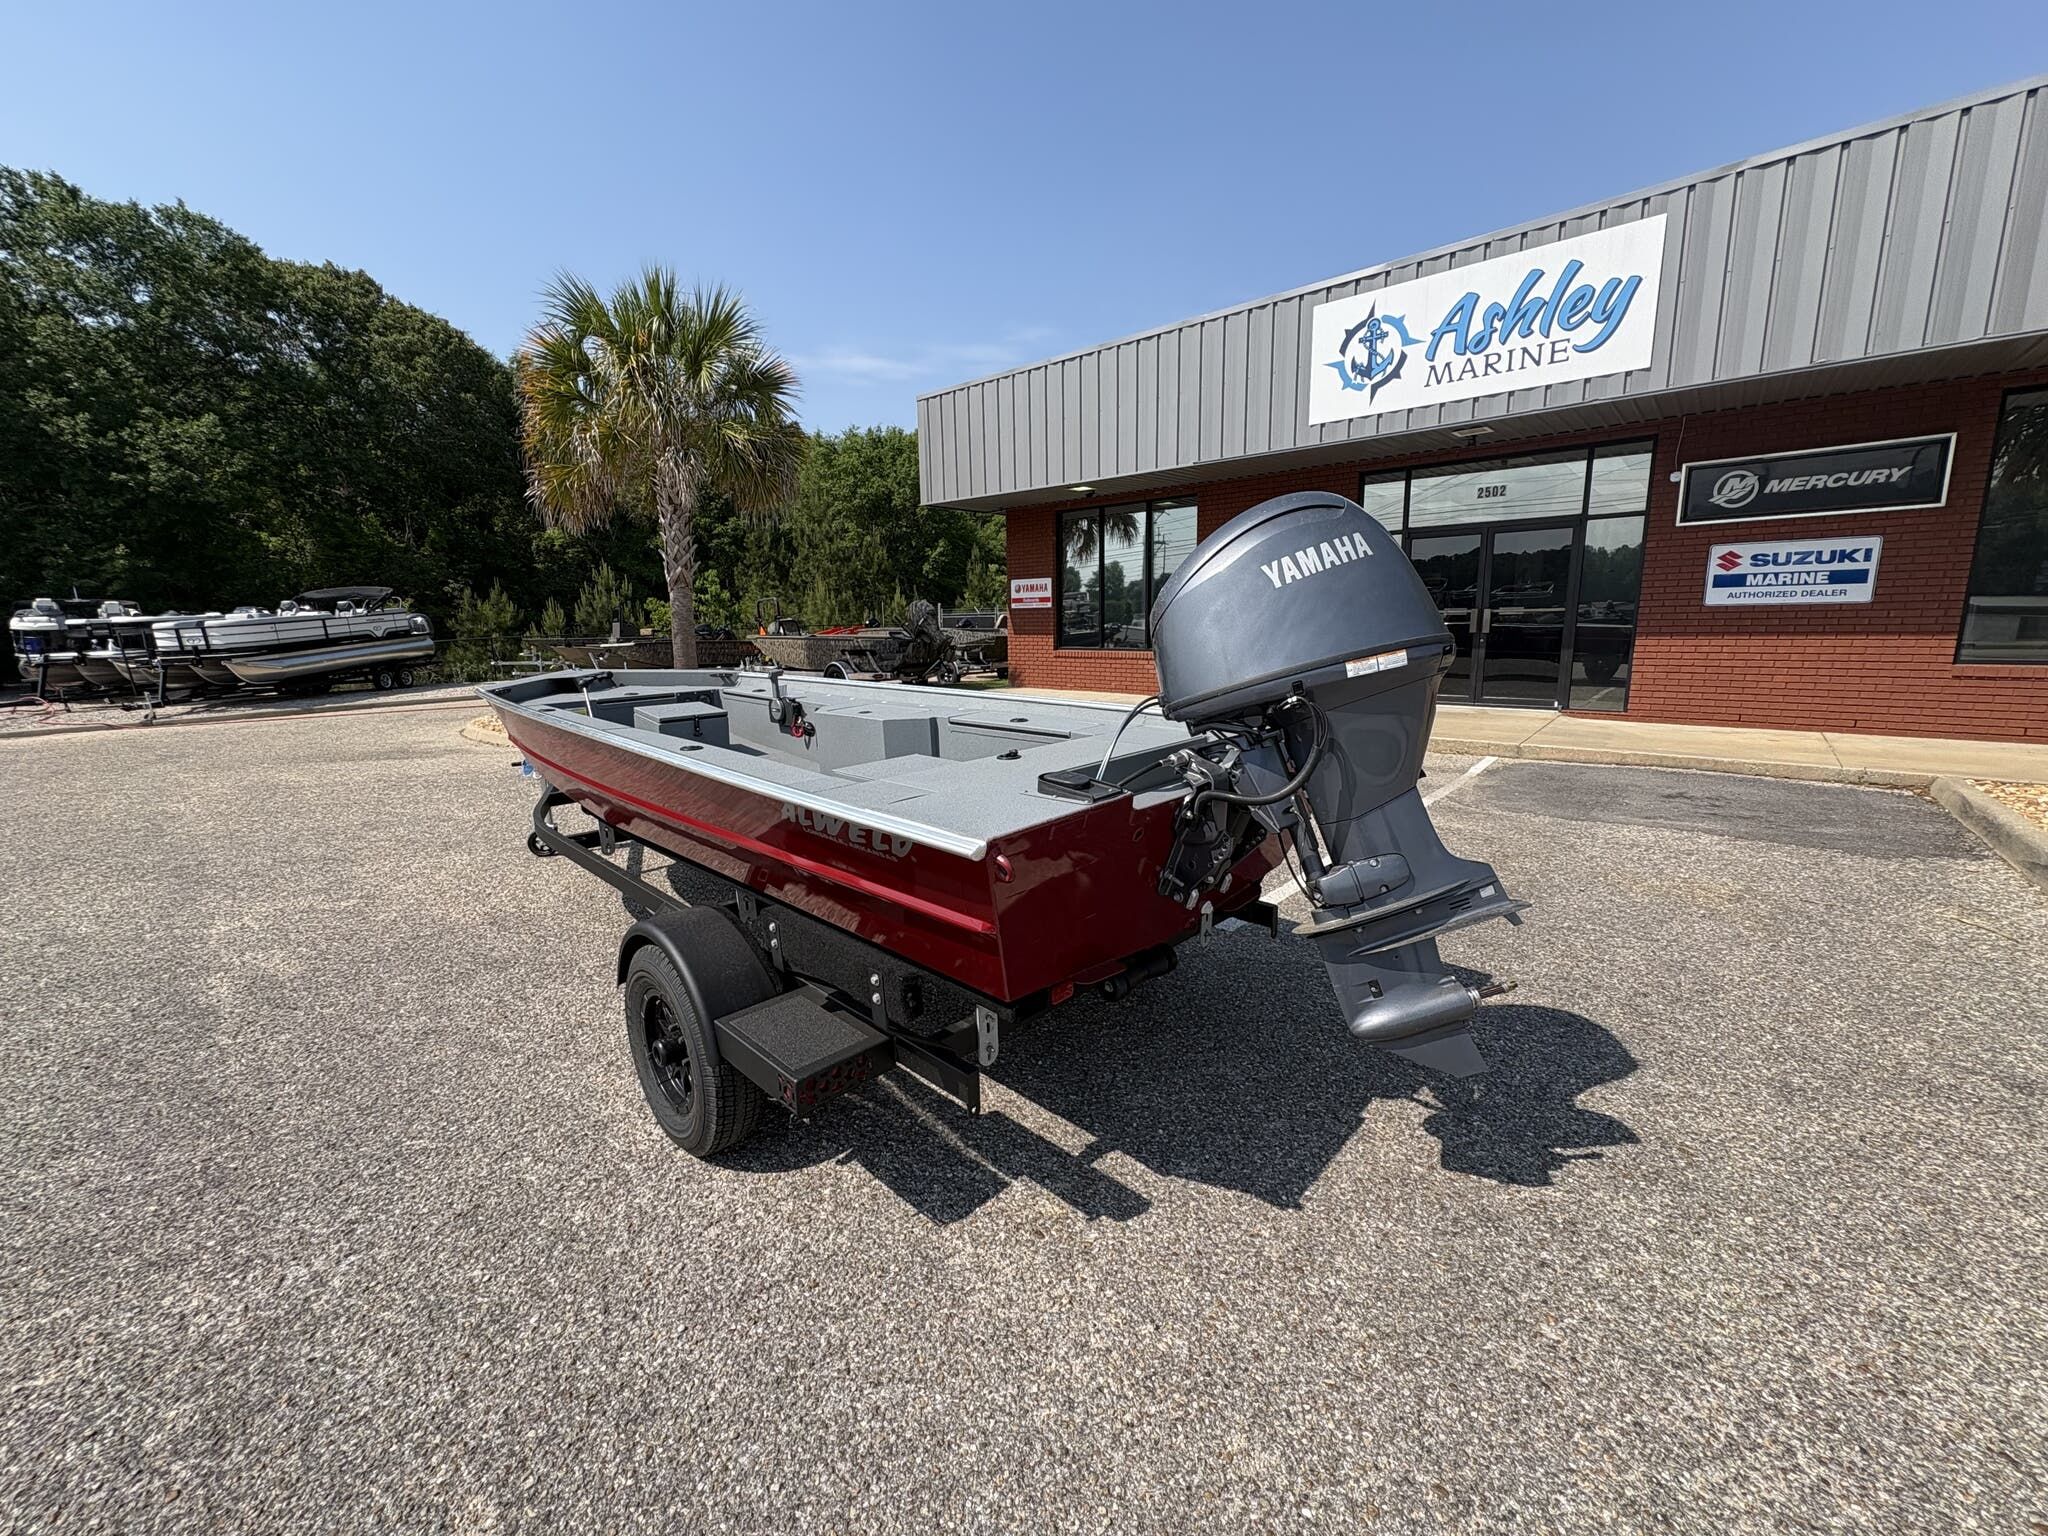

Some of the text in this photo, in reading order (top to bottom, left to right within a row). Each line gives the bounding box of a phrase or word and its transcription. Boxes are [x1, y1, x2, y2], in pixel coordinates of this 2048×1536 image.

[1425, 260, 1643, 361] Ashley
[1424, 338, 1572, 388] MARINE
[1764, 466, 1914, 494] MERCURY
[1477, 485, 1507, 499] 2502
[1260, 532, 1374, 589] YAMAHA
[1750, 548, 1873, 567] SUZUKI
[1021, 583, 1048, 593] YAMAHA
[1745, 571, 1830, 586] MARINE
[1727, 588, 1848, 599] AUTHORIZED DEALER
[781, 802, 913, 858] ALWELD
